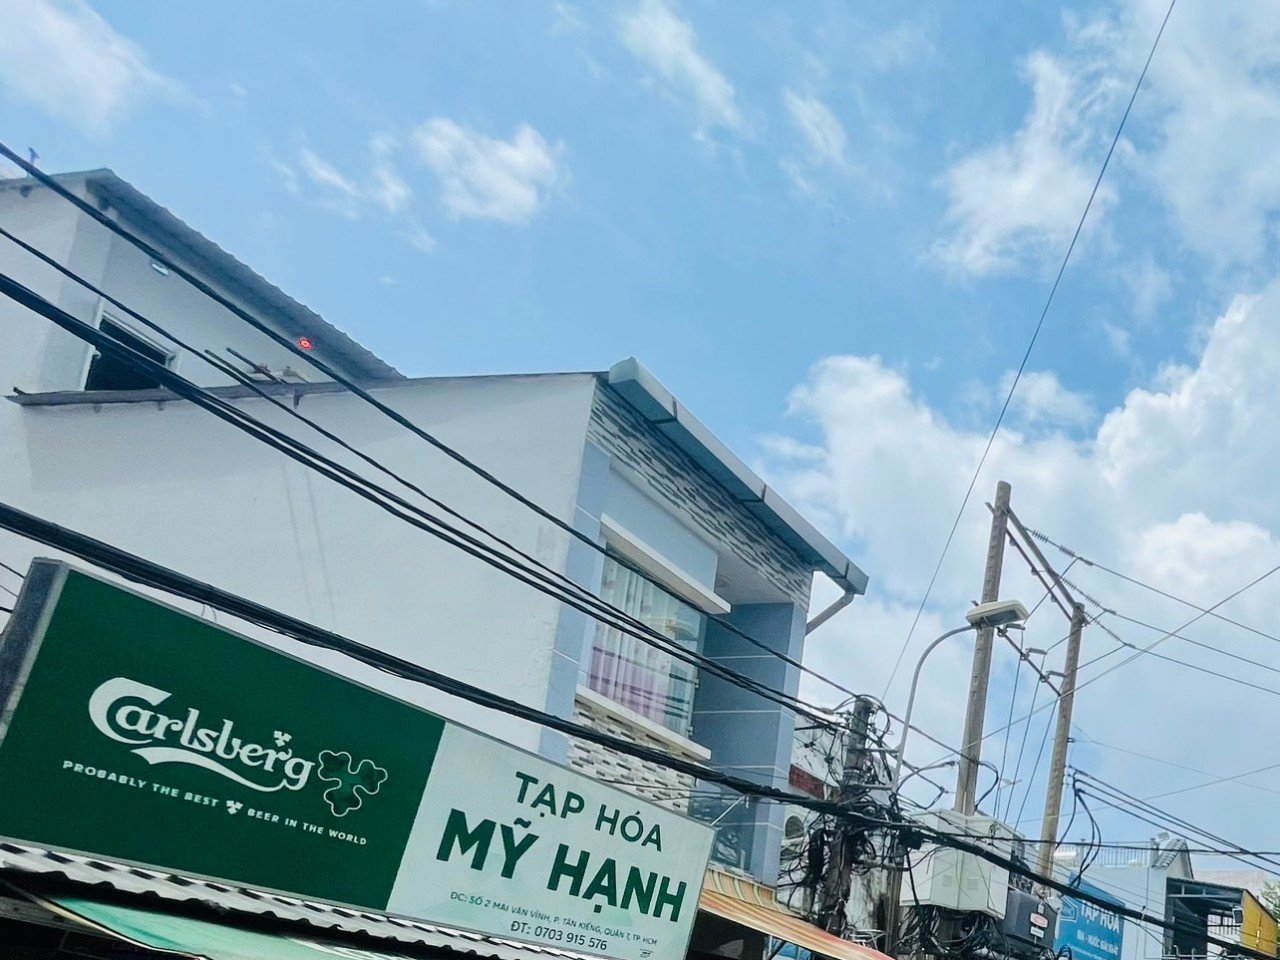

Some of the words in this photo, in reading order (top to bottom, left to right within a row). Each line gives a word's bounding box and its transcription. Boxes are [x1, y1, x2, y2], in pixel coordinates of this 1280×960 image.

[89, 677, 315, 791] Carlsberg
[63, 760, 146, 789] PROBABLY
[152, 783, 179, 798] THE
[184, 791, 219, 807] BEST
[247, 808, 279, 824] BEER
[285, 817, 297, 828] IN
[302, 822, 324, 835] THE
[329, 828, 367, 846] WORLD
[515, 771, 585, 819] TẠP
[595, 803, 662, 852] HÓA
[436, 808, 540, 880] MỸ
[547, 843, 687, 923] HẠNH
[484, 899, 491, 908] 2
[492, 901, 510, 912] MAI
[510, 920, 531, 935] ĐT:
[534, 925, 563, 942] 0703
[565, 932, 585, 947] 915
[587, 936, 608, 951] 576
